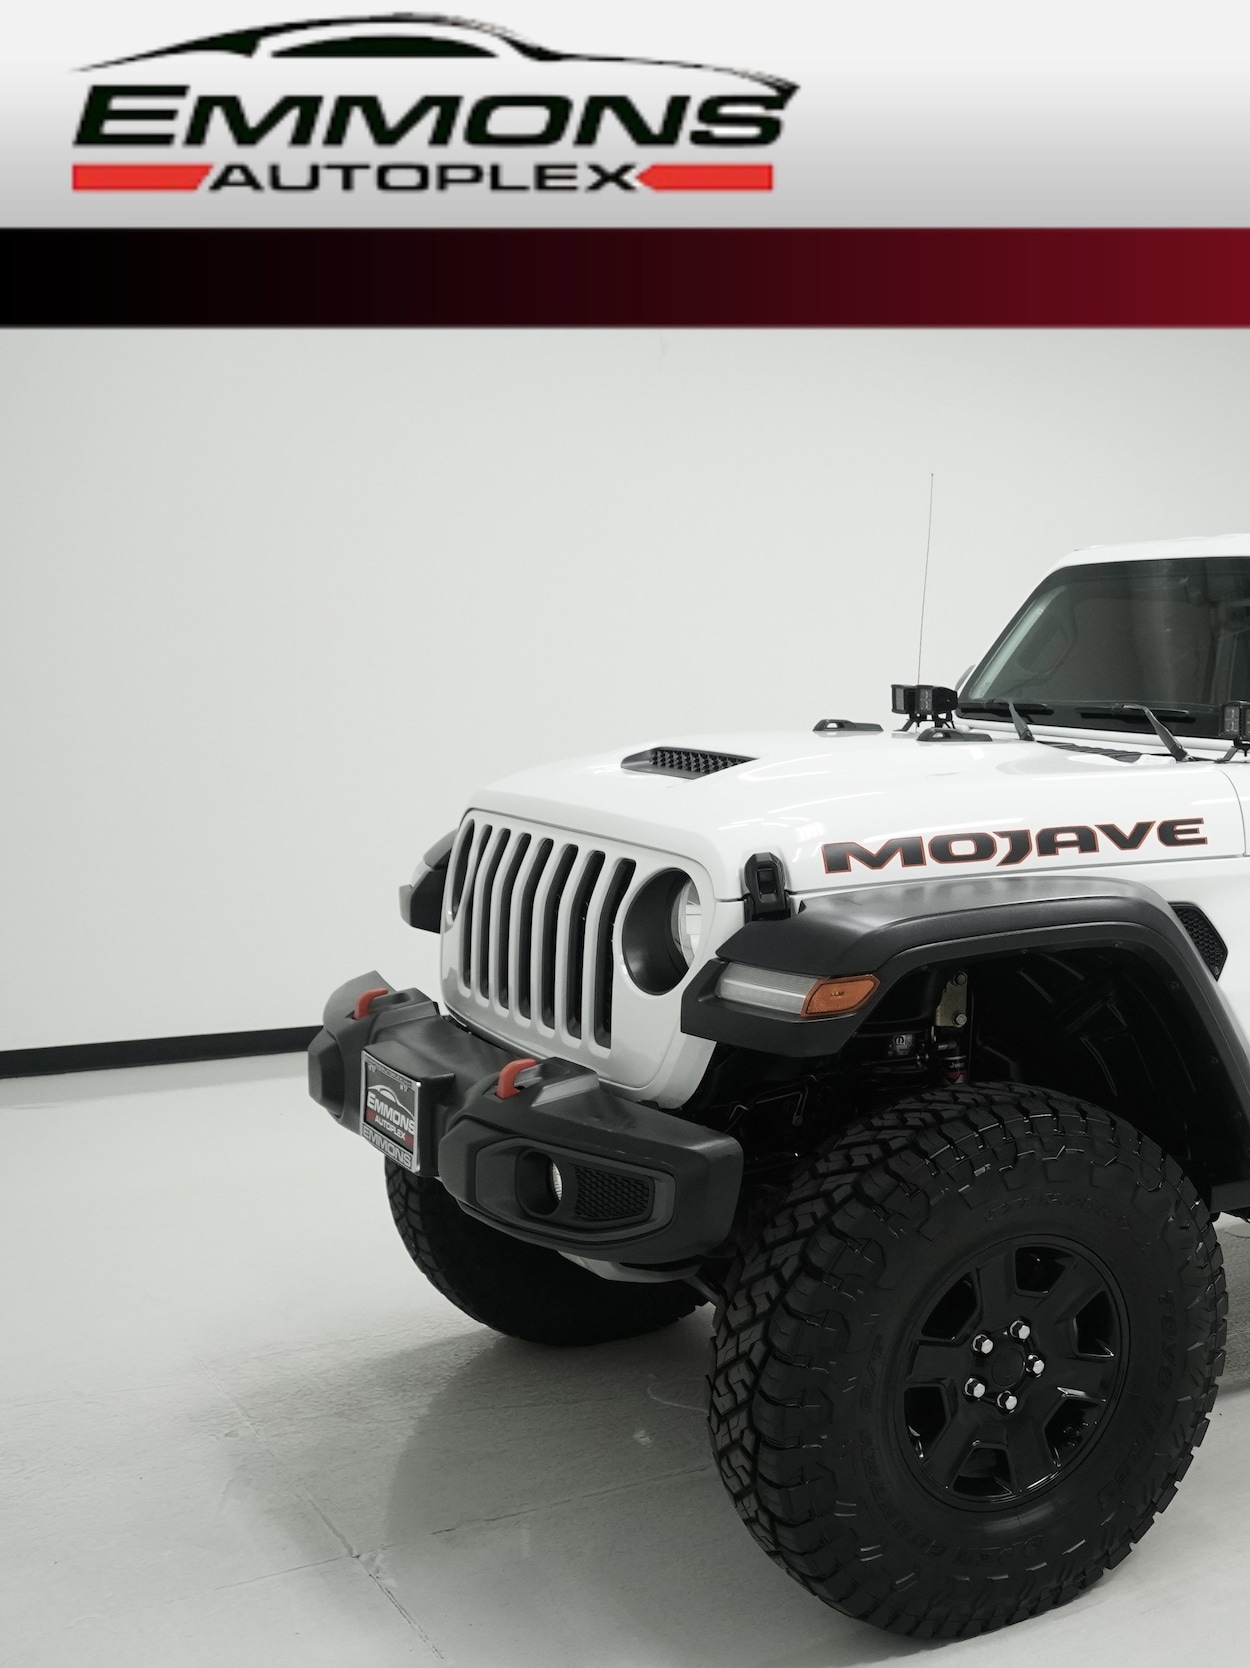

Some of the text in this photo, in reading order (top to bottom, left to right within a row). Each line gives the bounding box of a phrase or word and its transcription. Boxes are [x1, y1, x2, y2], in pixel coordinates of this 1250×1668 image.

[821, 817, 1209, 874] MOJAVE
[366, 1090, 416, 1136] EMMONS
[374, 1114, 407, 1141] AUTOPLEX
[363, 1126, 412, 1169] EMMONS
